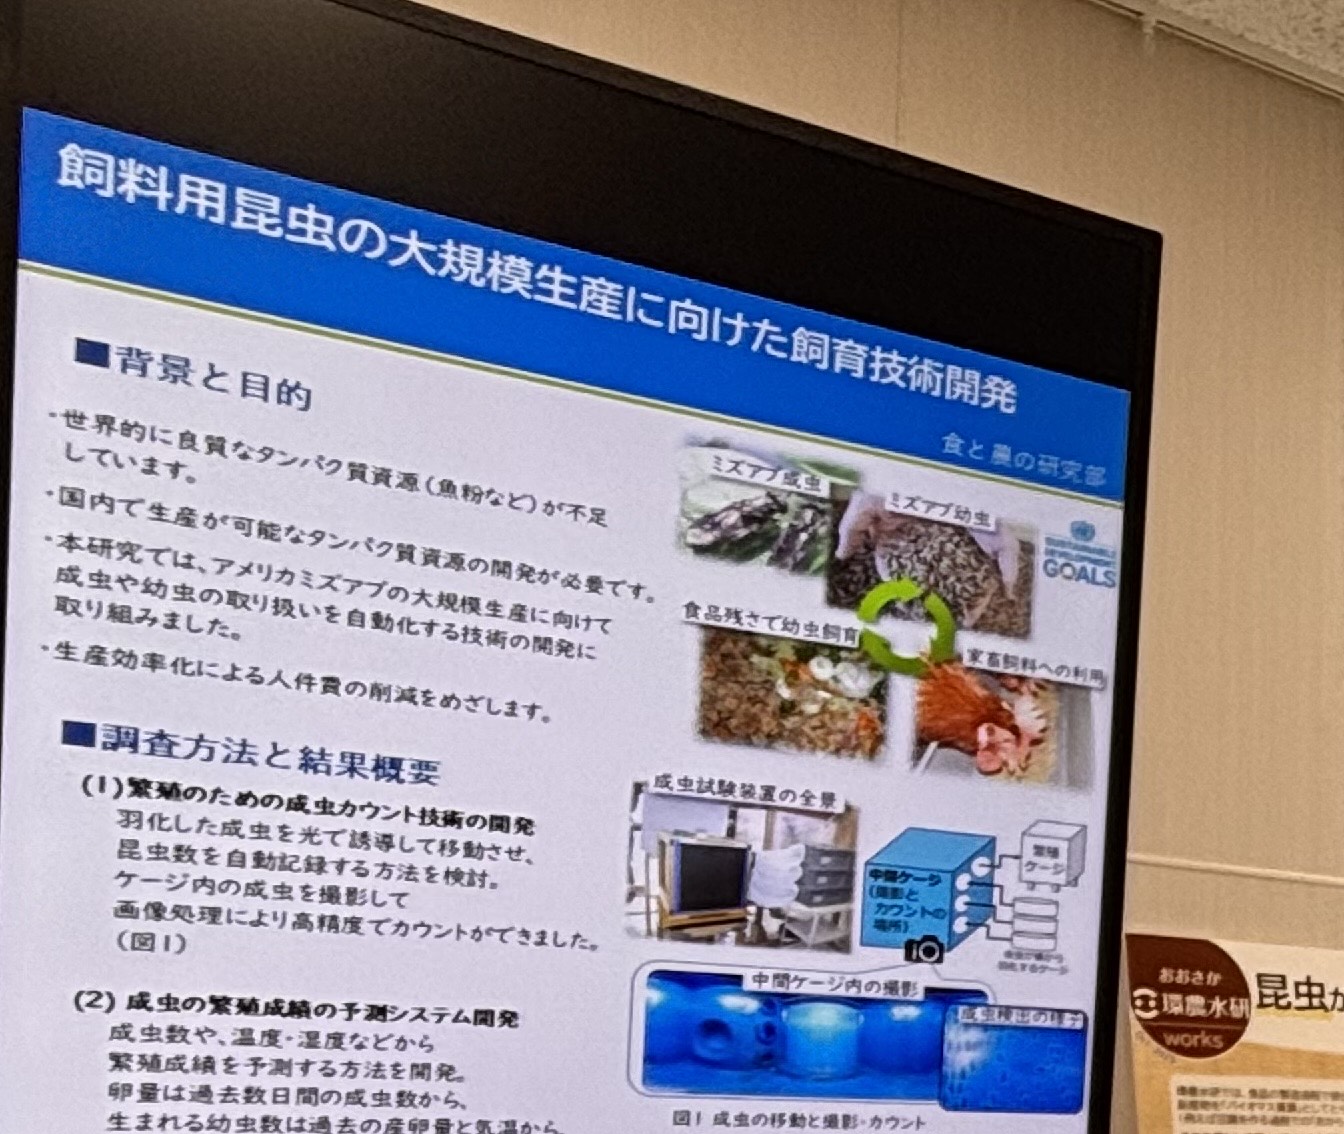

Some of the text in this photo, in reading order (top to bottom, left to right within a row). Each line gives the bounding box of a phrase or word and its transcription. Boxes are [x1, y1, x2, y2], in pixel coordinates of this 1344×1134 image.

[57, 142, 1019, 416] 飼料用昆虫の大規模生産に向けた飼育技術開発
[116, 345, 313, 412] 背景と目的
[65, 442, 198, 484] しています。
[711, 454, 823, 494] ミズアブ成虫
[942, 432, 1107, 487] 食と農の研究部
[889, 491, 992, 529] ミズアブ幼虫
[1043, 558, 1117, 588] GOALS
[55, 565, 598, 660] 成虫や幼虫の取り扱いを自動化する技術の開発に
[55, 595, 242, 642] 取り組みました。
[683, 601, 859, 646] 食品残さで幼虫飼育
[101, 723, 442, 786] 調査方法と結果概要
[653, 774, 837, 810] 成虫試験装置の全景
[113, 870, 411, 910] ケージ内の成虫を撮影して
[751, 971, 920, 998] 中間ケージ内の撮影
[1158, 967, 1223, 987] おおさか
[1163, 1030, 1224, 1050] works
